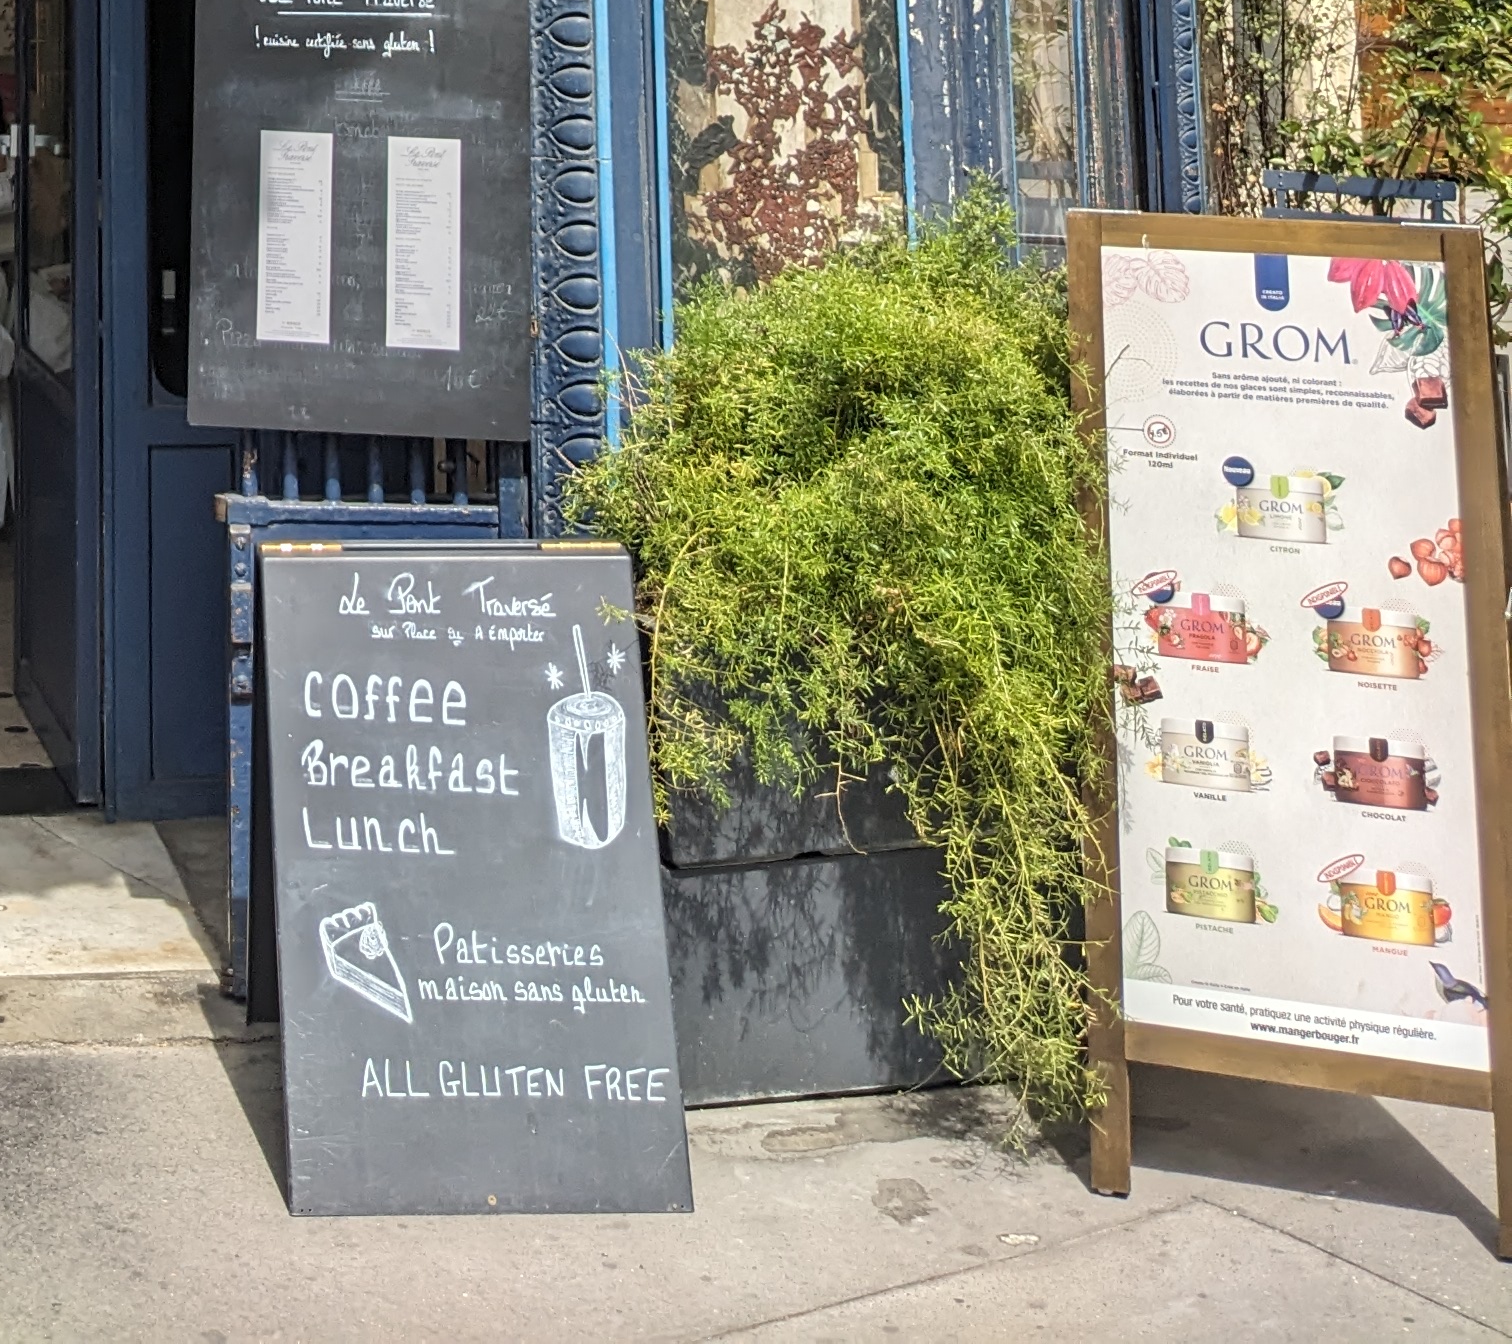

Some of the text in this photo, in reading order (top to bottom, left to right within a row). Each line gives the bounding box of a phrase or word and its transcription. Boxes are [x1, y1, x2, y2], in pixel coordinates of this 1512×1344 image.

[263, 33, 299, 47] cuisine
[352, 38, 375, 50] sans
[382, 31, 420, 57] gluten
[1199, 320, 1353, 365] GROM
[1212, 372, 1231, 381] Sans
[1233, 373, 1259, 383] arôme
[1261, 374, 1290, 385] ajouté,
[1302, 377, 1337, 387] colorant
[1169, 388, 1209, 398] élaborées
[1217, 392, 1241, 400] partir
[1243, 392, 1254, 400] de
[1255, 393, 1294, 403] matières
[1295, 396, 1340, 406] premières
[1342, 399, 1353, 407] de
[1355, 399, 1389, 409] qualité.
[1176, 379, 1209, 388] recettes
[1211, 381, 1222, 389] de
[1240, 383, 1267, 392] glaces
[1289, 386, 1323, 397] simples,
[1325, 389, 1395, 401] reconnaissables,
[1123, 448, 1198, 461] Format Individuel
[1259, 500, 1303, 514] GROM
[339, 572, 556, 617] Le Pont Traversé
[371, 625, 395, 639] sur
[402, 621, 437, 639] Place
[475, 625, 484, 640] A
[1181, 619, 1224, 633] GROM
[1351, 633, 1396, 648] GROM
[1358, 681, 1398, 691] NOISETTE
[1184, 745, 1227, 761] GROM
[300, 738, 521, 797] Breakfast
[1193, 792, 1227, 801] VANILLE
[1361, 811, 1406, 822] CHOCOLAT
[302, 806, 455, 856] Lunch
[1188, 875, 1232, 891] GROM
[1364, 897, 1411, 913] GROM
[1195, 923, 1234, 933] PISTACHE
[432, 921, 605, 967] Patisseries
[1372, 946, 1408, 956] MANGUE
[417, 975, 646, 1014] maison sans gluten
[1172, 994, 1437, 1041] Pour votre santé, pratiquez une activité physique régulière.
[1250, 1020, 1360, 1045] www.mangerbouger.fr
[361, 1057, 670, 1102] ALL GLUTEN FREE
